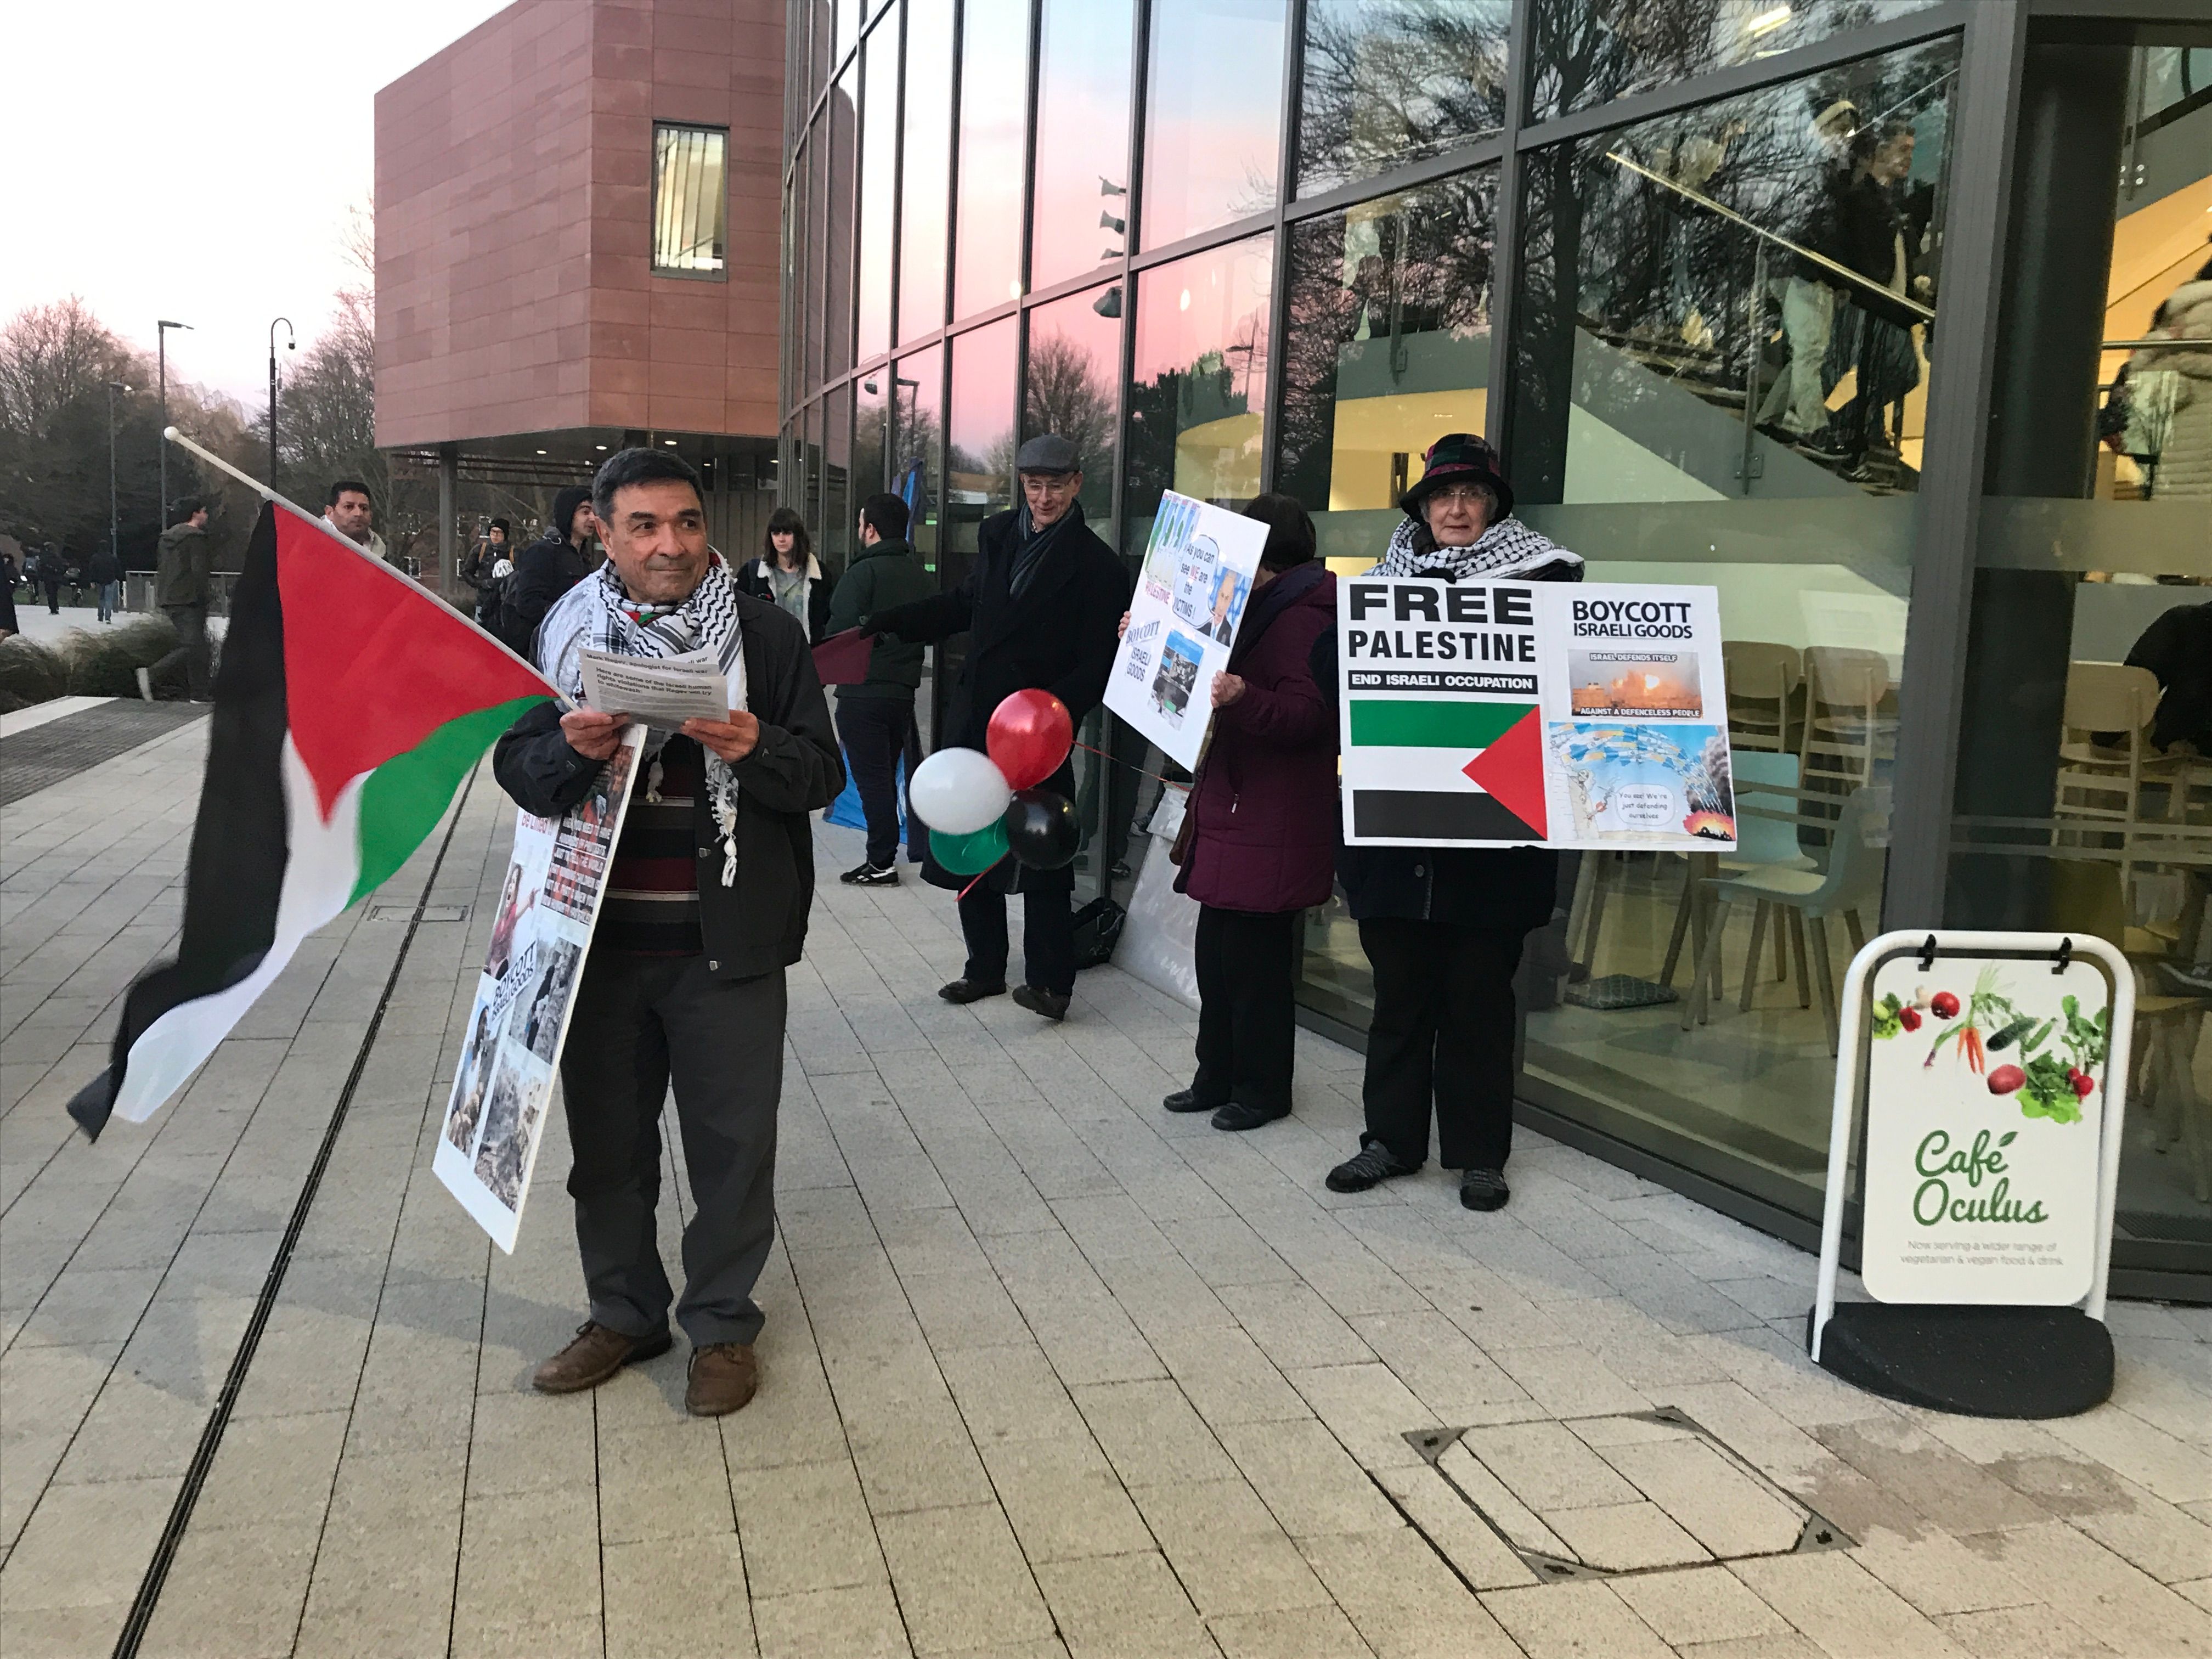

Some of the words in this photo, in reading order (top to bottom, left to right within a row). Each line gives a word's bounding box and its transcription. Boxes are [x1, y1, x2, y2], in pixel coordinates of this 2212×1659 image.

[1193, 547, 1204, 560] you
[1204, 552, 1215, 564] can
[1181, 563, 1190, 575] see
[1190, 564, 1200, 579] WE
[1198, 572, 1208, 584] are
[1145, 580, 1171, 605] PALESTINE
[1184, 582, 1193, 595] the
[1348, 583, 1534, 626] FREE
[1572, 600, 1691, 623] BOYCOTT
[1126, 620, 1161, 644] BOYCOTT
[1573, 622, 1632, 637] ISRAELI
[1634, 624, 1693, 639] GOODS
[1131, 646, 1151, 666] ISRAELI
[1348, 630, 1536, 663] PALESTINE
[596, 667, 611, 675] Here
[629, 661, 660, 670] apologist
[1127, 662, 1146, 682] GOODS
[597, 673, 616, 682] rights
[617, 678, 650, 690] violations
[1351, 674, 1381, 686] END
[1385, 674, 1440, 687] ISRAELI
[1444, 675, 1533, 690] OCCUPATION
[1673, 709, 1700, 717] PEOPLE
[493, 940, 537, 1007] BOYCOTT
[1915, 1129, 2019, 1188] Café
[1913, 1177, 2050, 1226] Oculus
[1908, 1240, 1932, 1250] Now
[1933, 1242, 1971, 1252] serving
[1972, 1243, 1980, 1251] a
[1982, 1242, 2010, 1251] wider
[2013, 1243, 2043, 1253] range
[2046, 1242, 2057, 1252] of
[1899, 1255, 1955, 1265] vegetarian
[1957, 1255, 1964, 1264] &
[1966, 1256, 1999, 1266] vegan
[2000, 1254, 2026, 1265] food
[2028, 1256, 2035, 1265] &
[2036, 1255, 2064, 1266] drink
